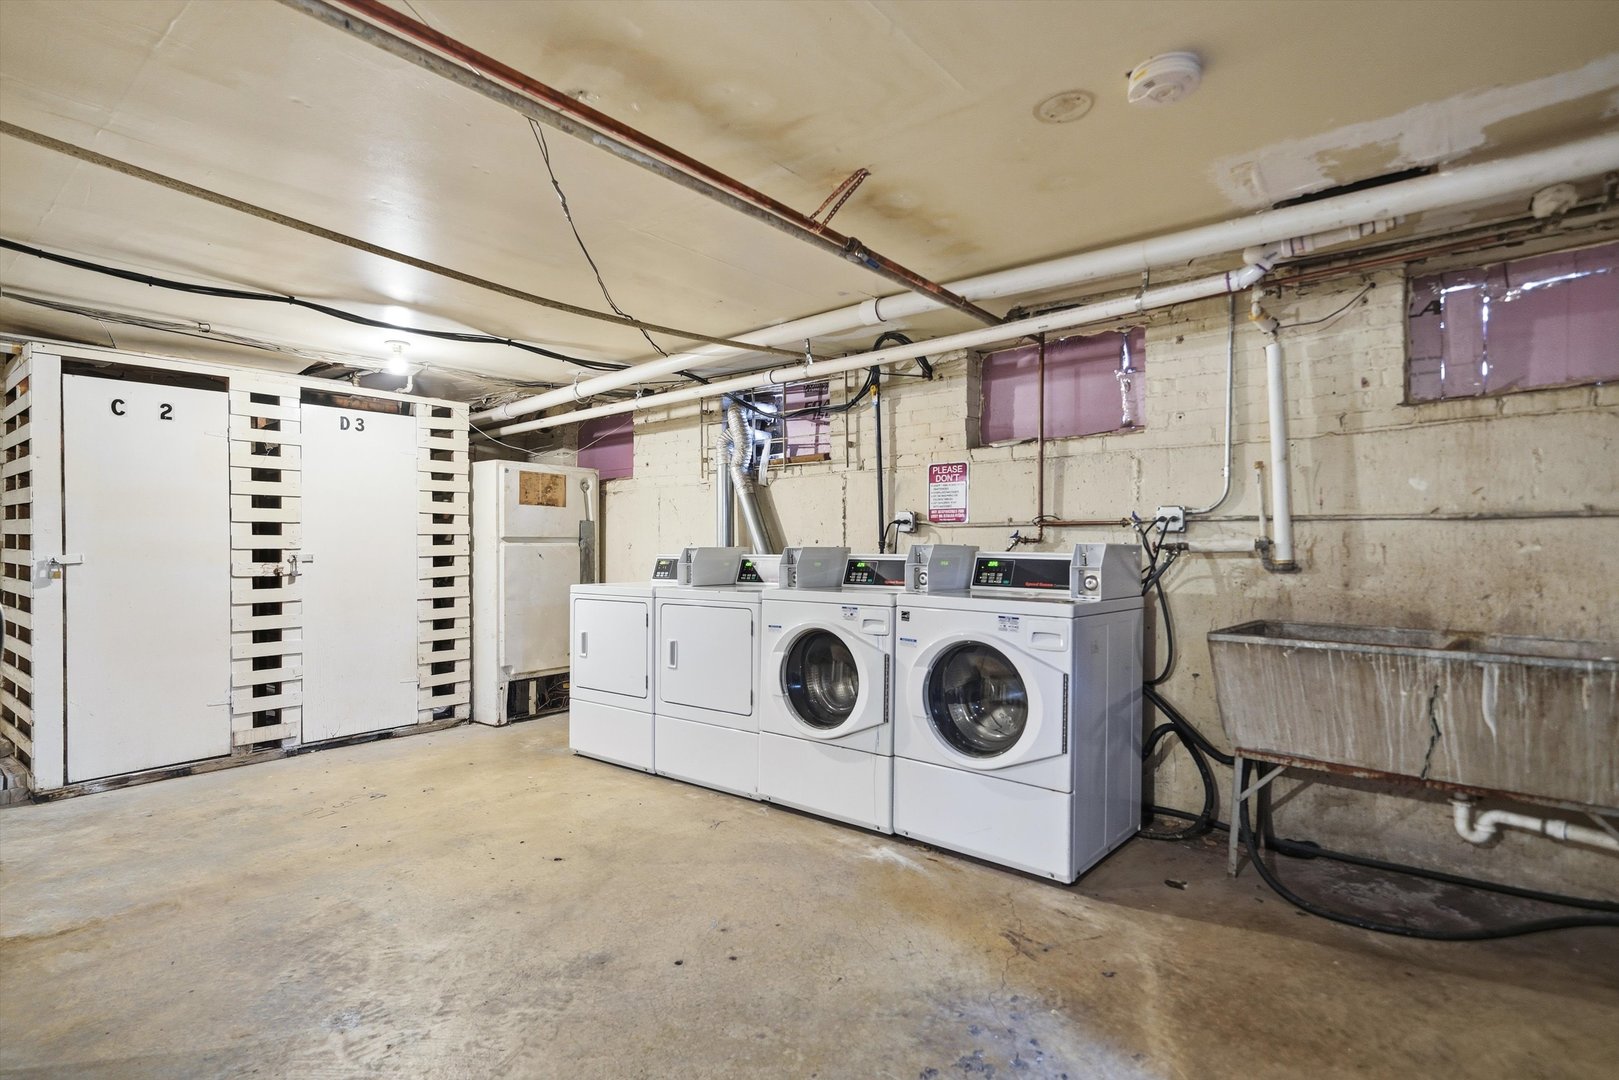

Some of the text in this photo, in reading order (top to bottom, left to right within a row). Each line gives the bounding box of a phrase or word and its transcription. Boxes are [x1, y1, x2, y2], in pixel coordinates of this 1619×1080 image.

[111, 399, 172, 420] C 2
[932, 465, 963, 474] PLEASE
[935, 474, 960, 482] DON'T
